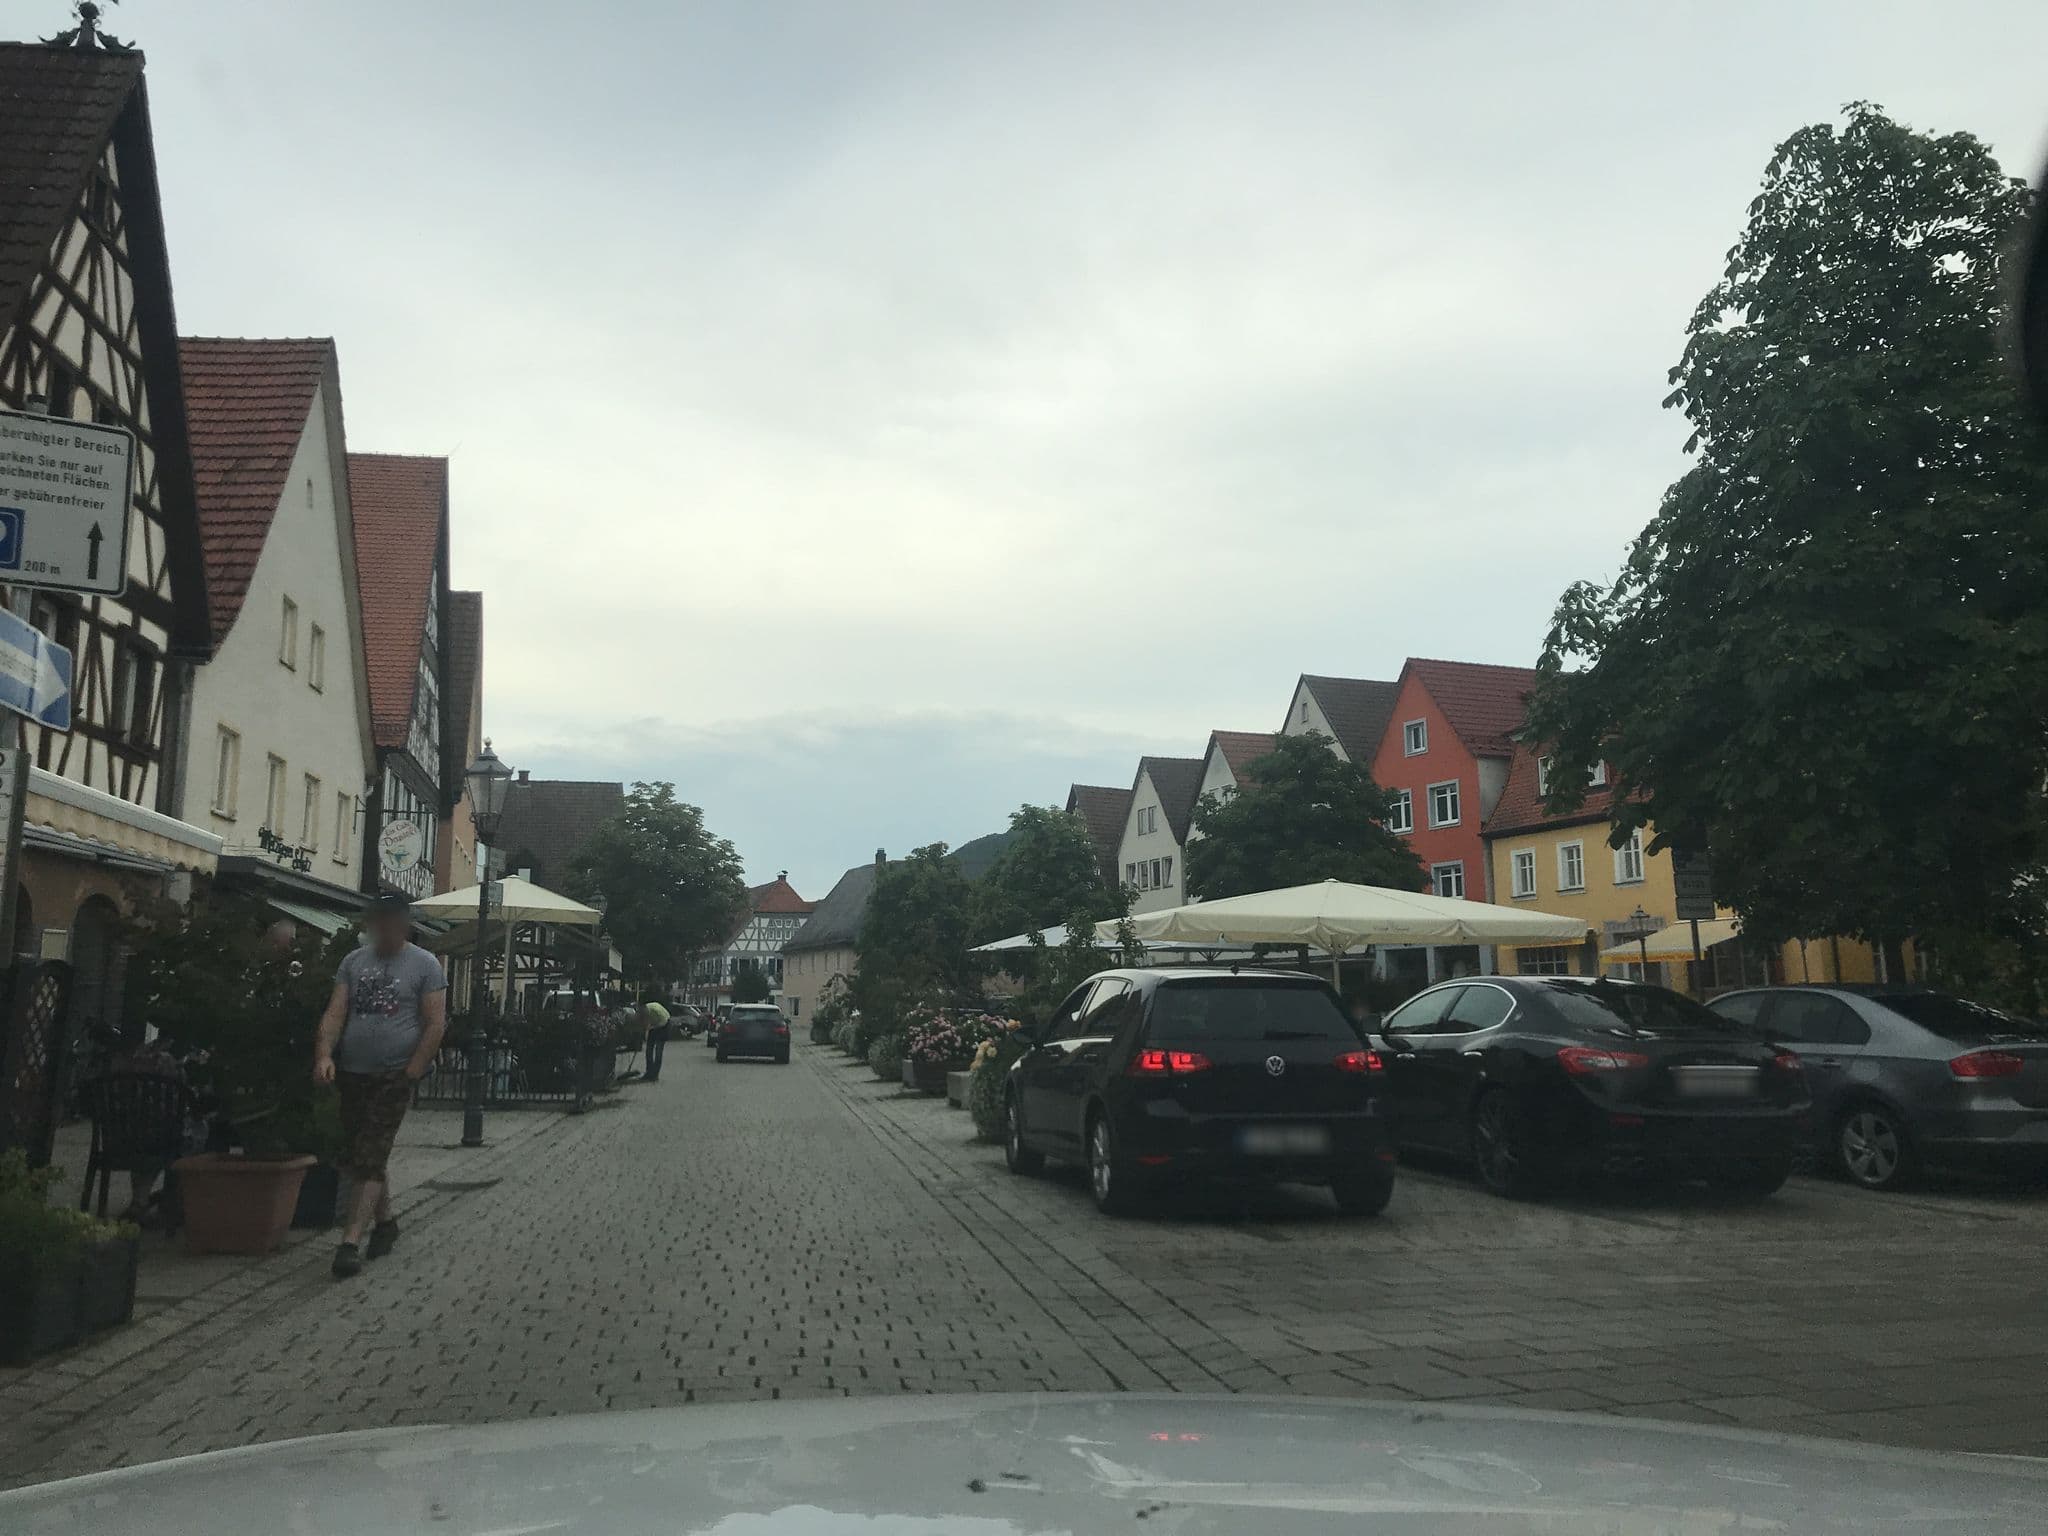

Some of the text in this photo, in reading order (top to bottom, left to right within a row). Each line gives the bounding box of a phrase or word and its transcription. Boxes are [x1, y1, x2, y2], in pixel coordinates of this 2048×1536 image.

[0, 427, 125, 456] beruhigter Bereich.
[38, 454, 56, 468] Sie
[60, 459, 80, 471] nur
[84, 463, 103, 475] auf
[14, 488, 105, 510] gebührenfreier
[50, 566, 60, 575] m
